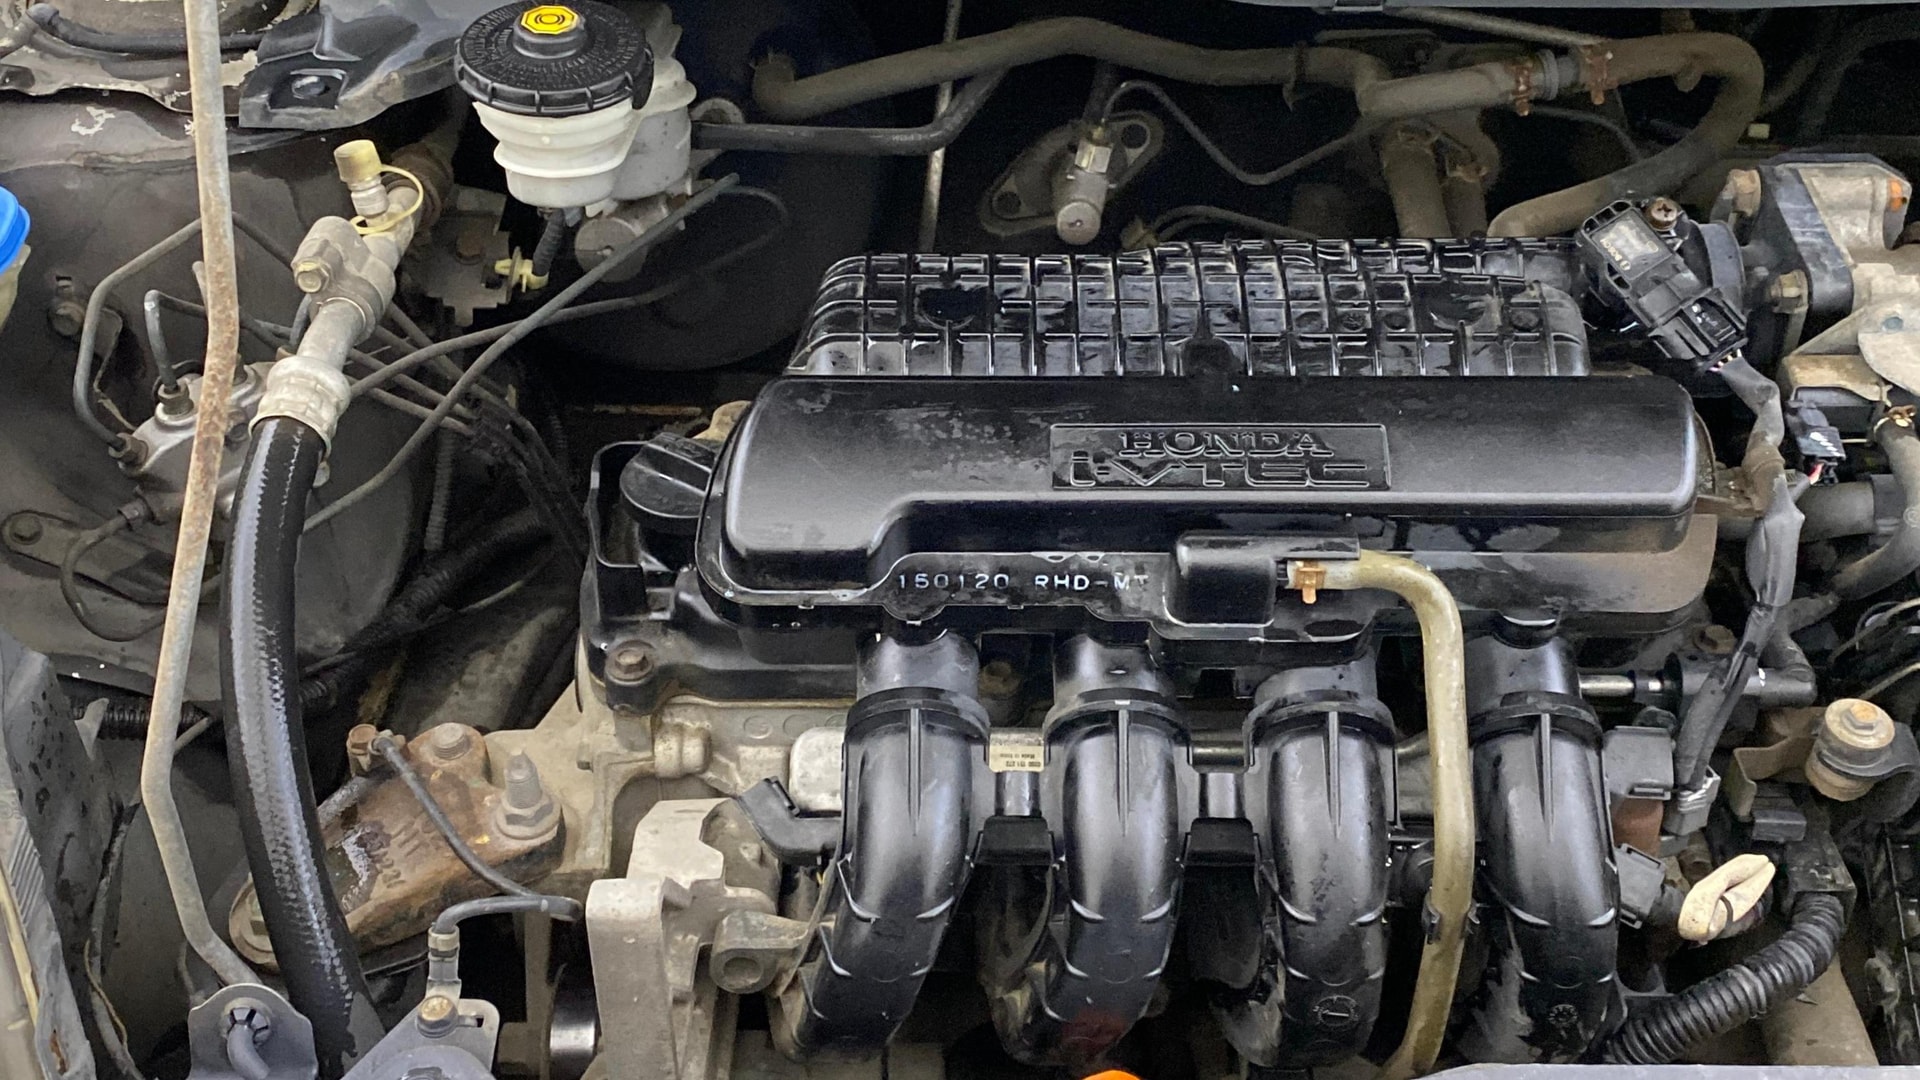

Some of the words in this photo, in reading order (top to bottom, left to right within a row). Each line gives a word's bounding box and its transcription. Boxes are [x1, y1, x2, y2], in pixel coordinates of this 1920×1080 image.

[1118, 431, 1335, 457] HONDA
[898, 572, 1011, 590] 150120
[1033, 573, 1150, 591] RHD-MT
